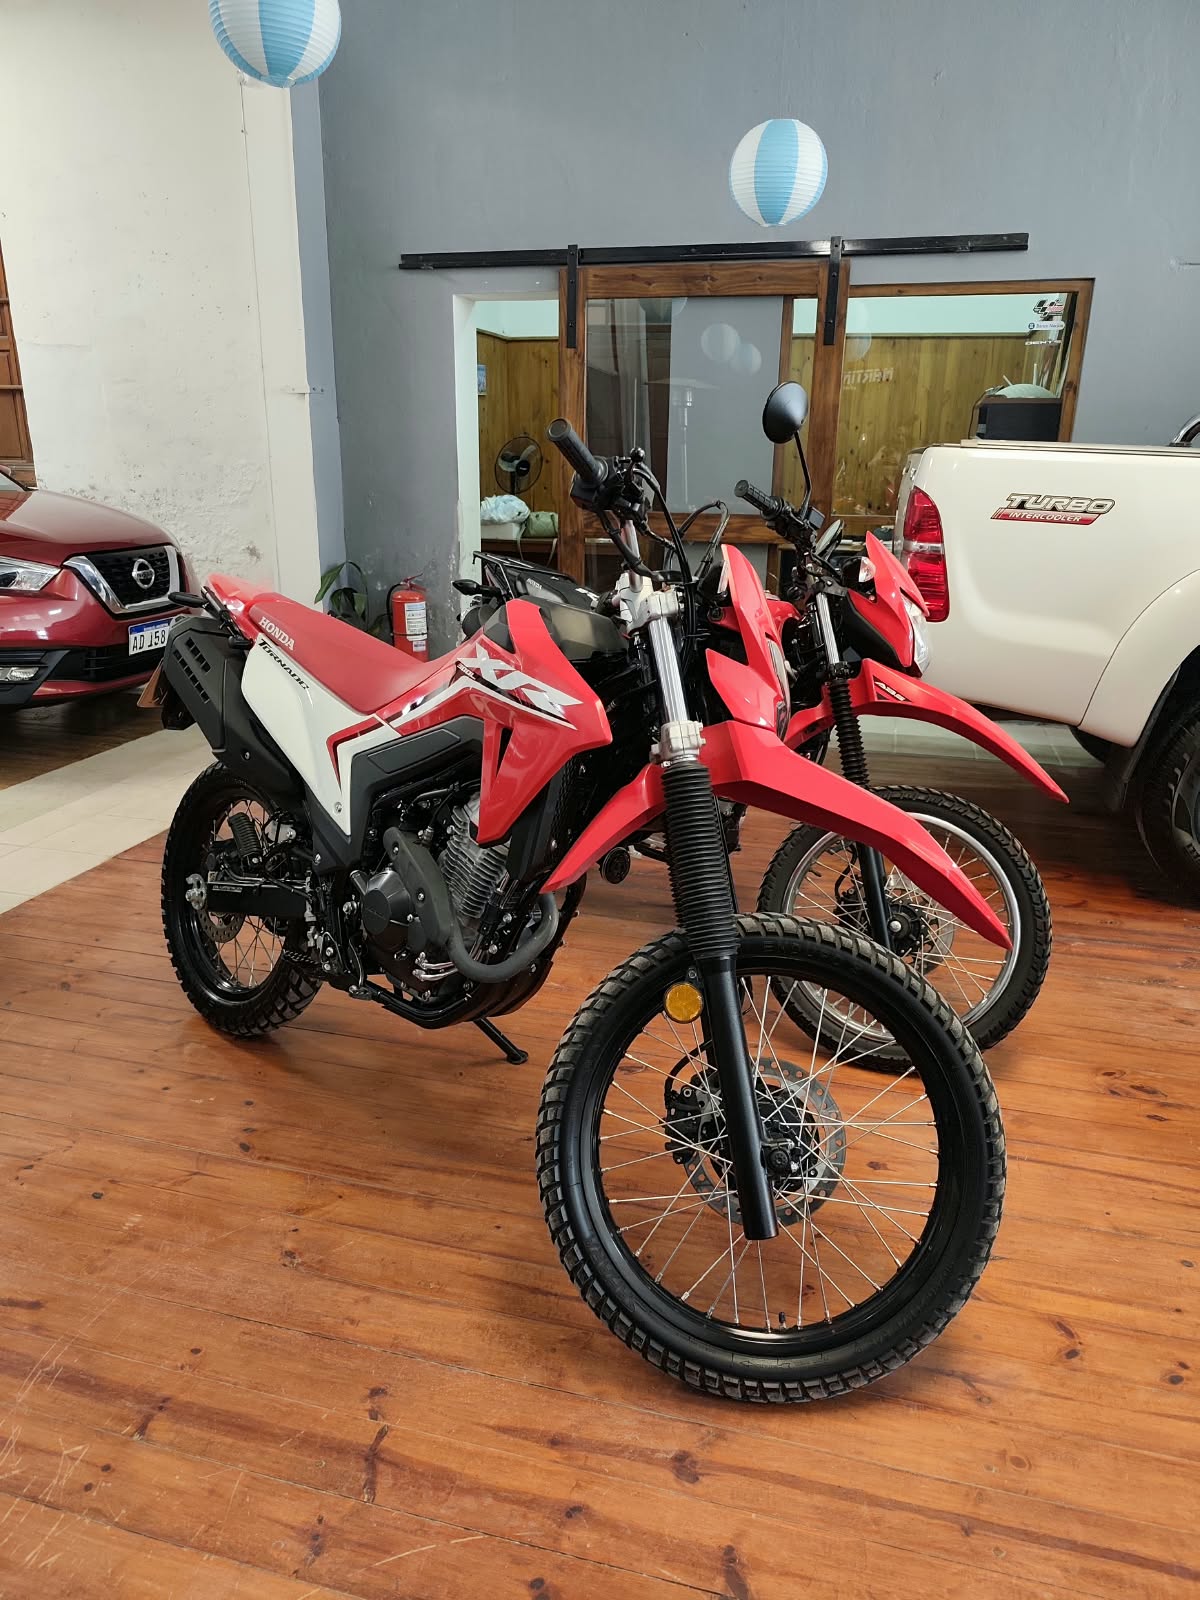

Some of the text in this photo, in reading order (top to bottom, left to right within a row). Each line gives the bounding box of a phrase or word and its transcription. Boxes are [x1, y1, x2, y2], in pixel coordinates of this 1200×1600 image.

[1006, 493, 1115, 514] TURBO
[1008, 512, 1082, 522] INTERCOOLER
[133, 629, 166, 652] AD 158
[258, 616, 295, 651] HONDA
[258, 638, 310, 690] TORNADO
